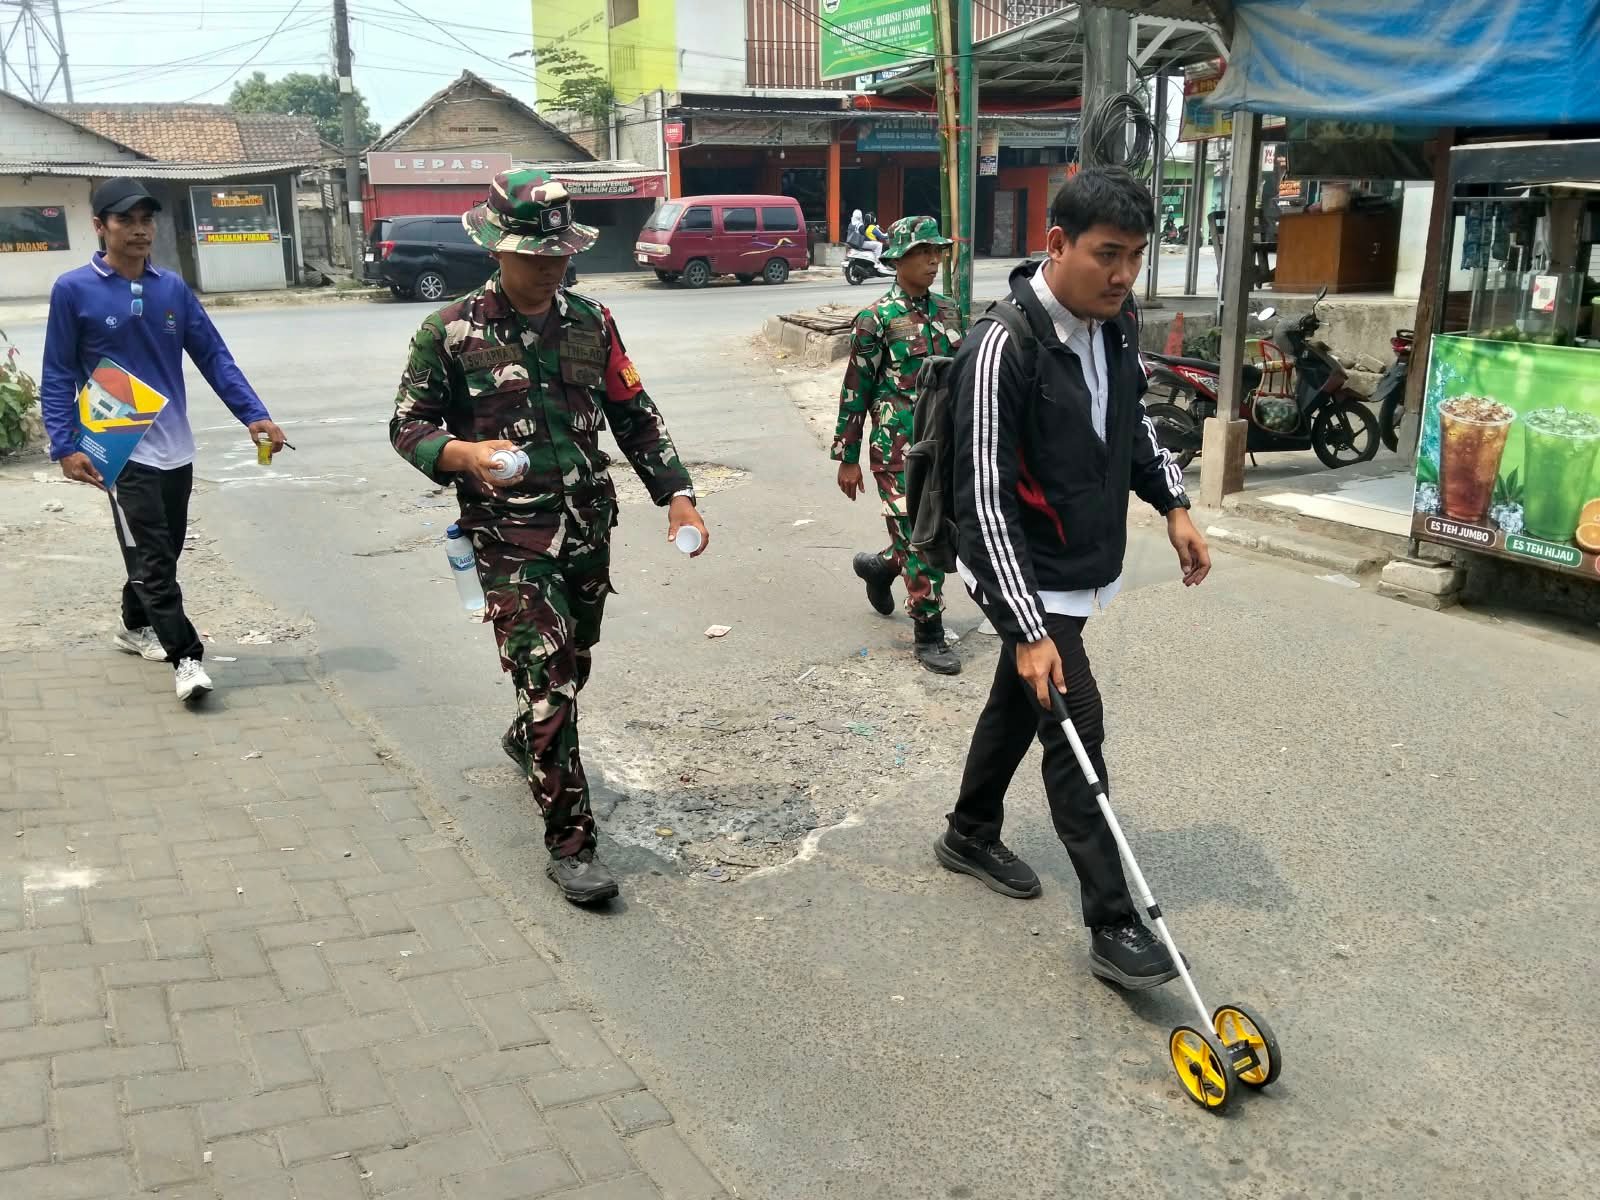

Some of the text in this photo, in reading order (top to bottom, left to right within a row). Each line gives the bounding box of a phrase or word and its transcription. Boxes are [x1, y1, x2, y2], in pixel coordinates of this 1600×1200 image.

[16, 242, 48, 252] PADANG
[1430, 521, 1489, 542] ES TEH JUMBO
[1513, 540, 1574, 562] ES TEH HIJAU
